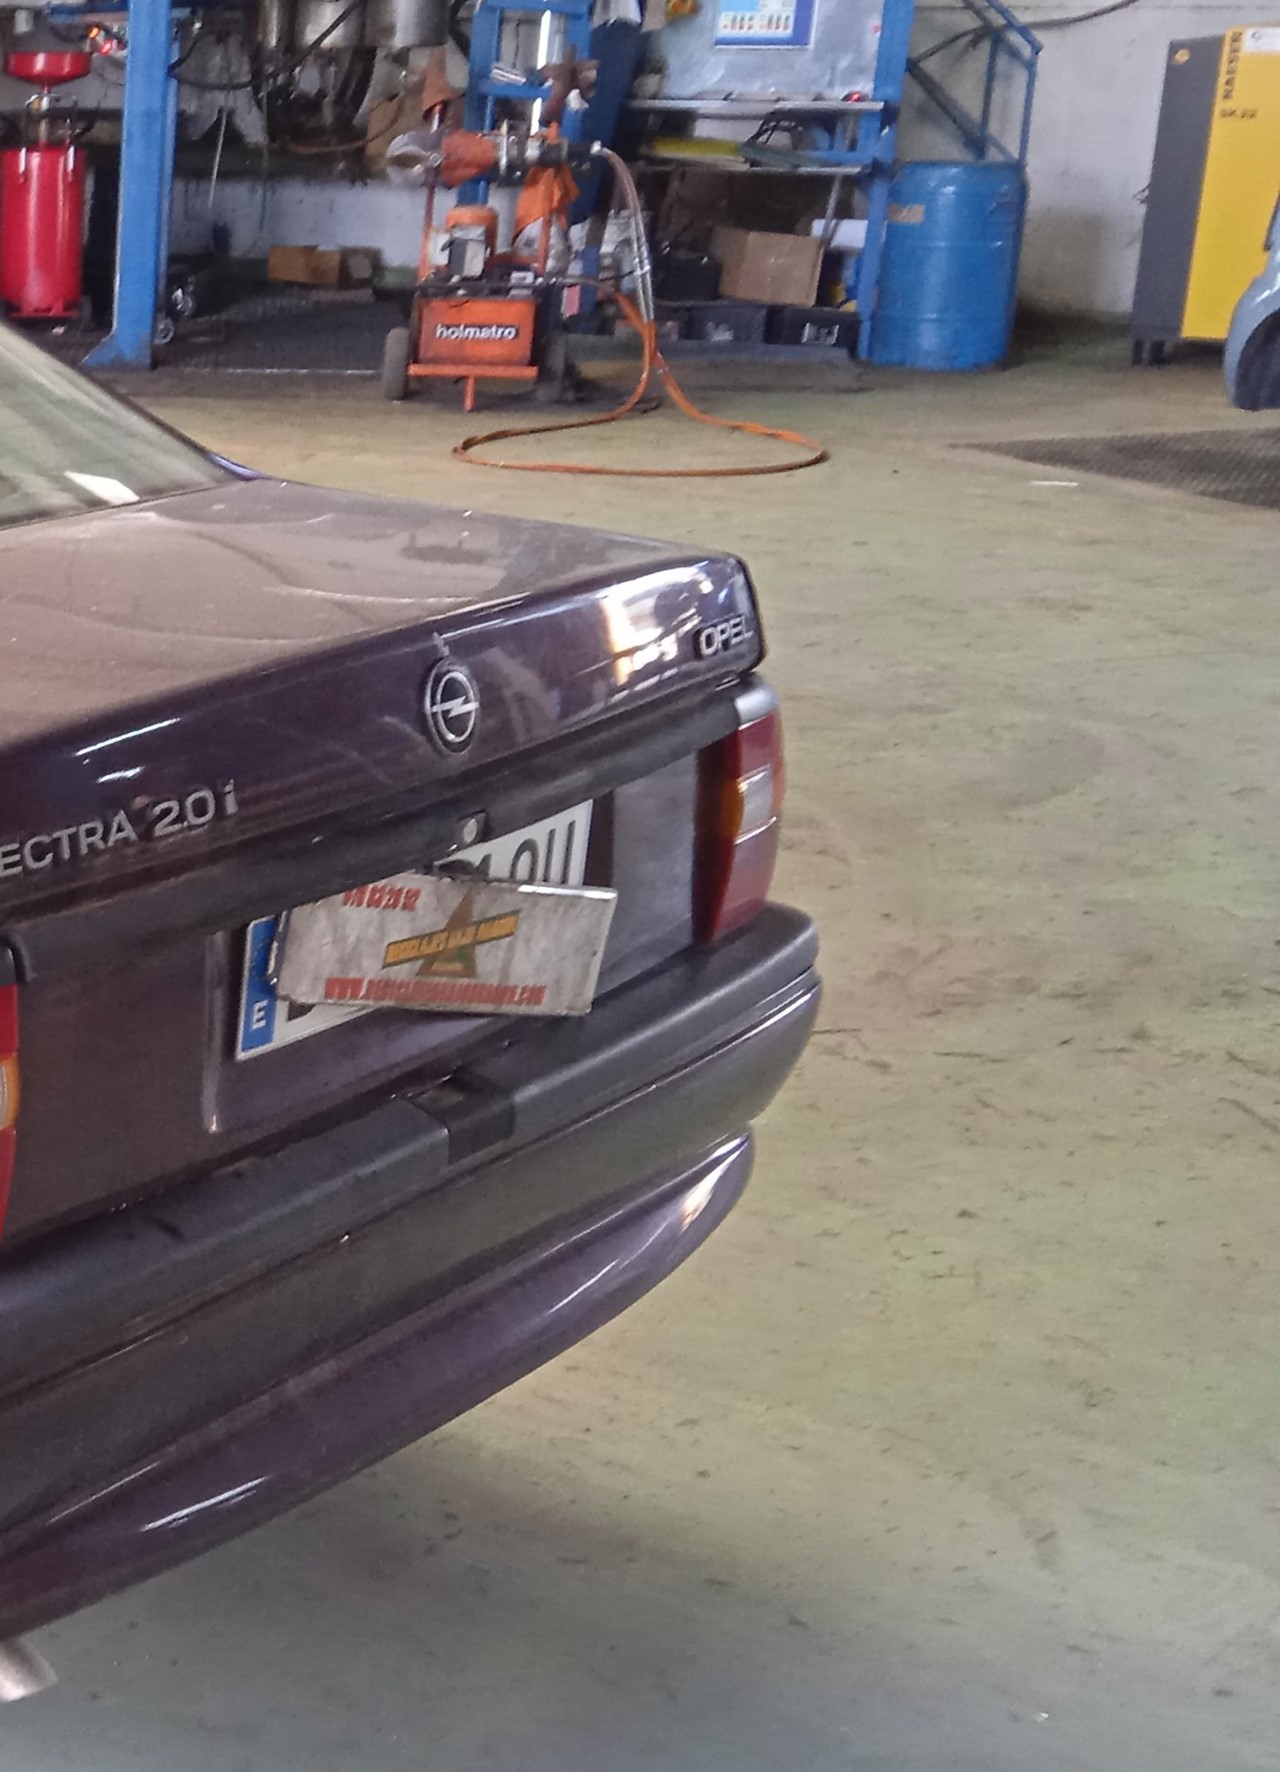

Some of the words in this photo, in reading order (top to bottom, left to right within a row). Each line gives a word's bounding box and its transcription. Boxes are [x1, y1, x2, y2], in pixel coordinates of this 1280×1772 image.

[435, 323, 518, 340] holmatro
[699, 614, 754, 657] OPEL
[251, 998, 270, 1031] E
